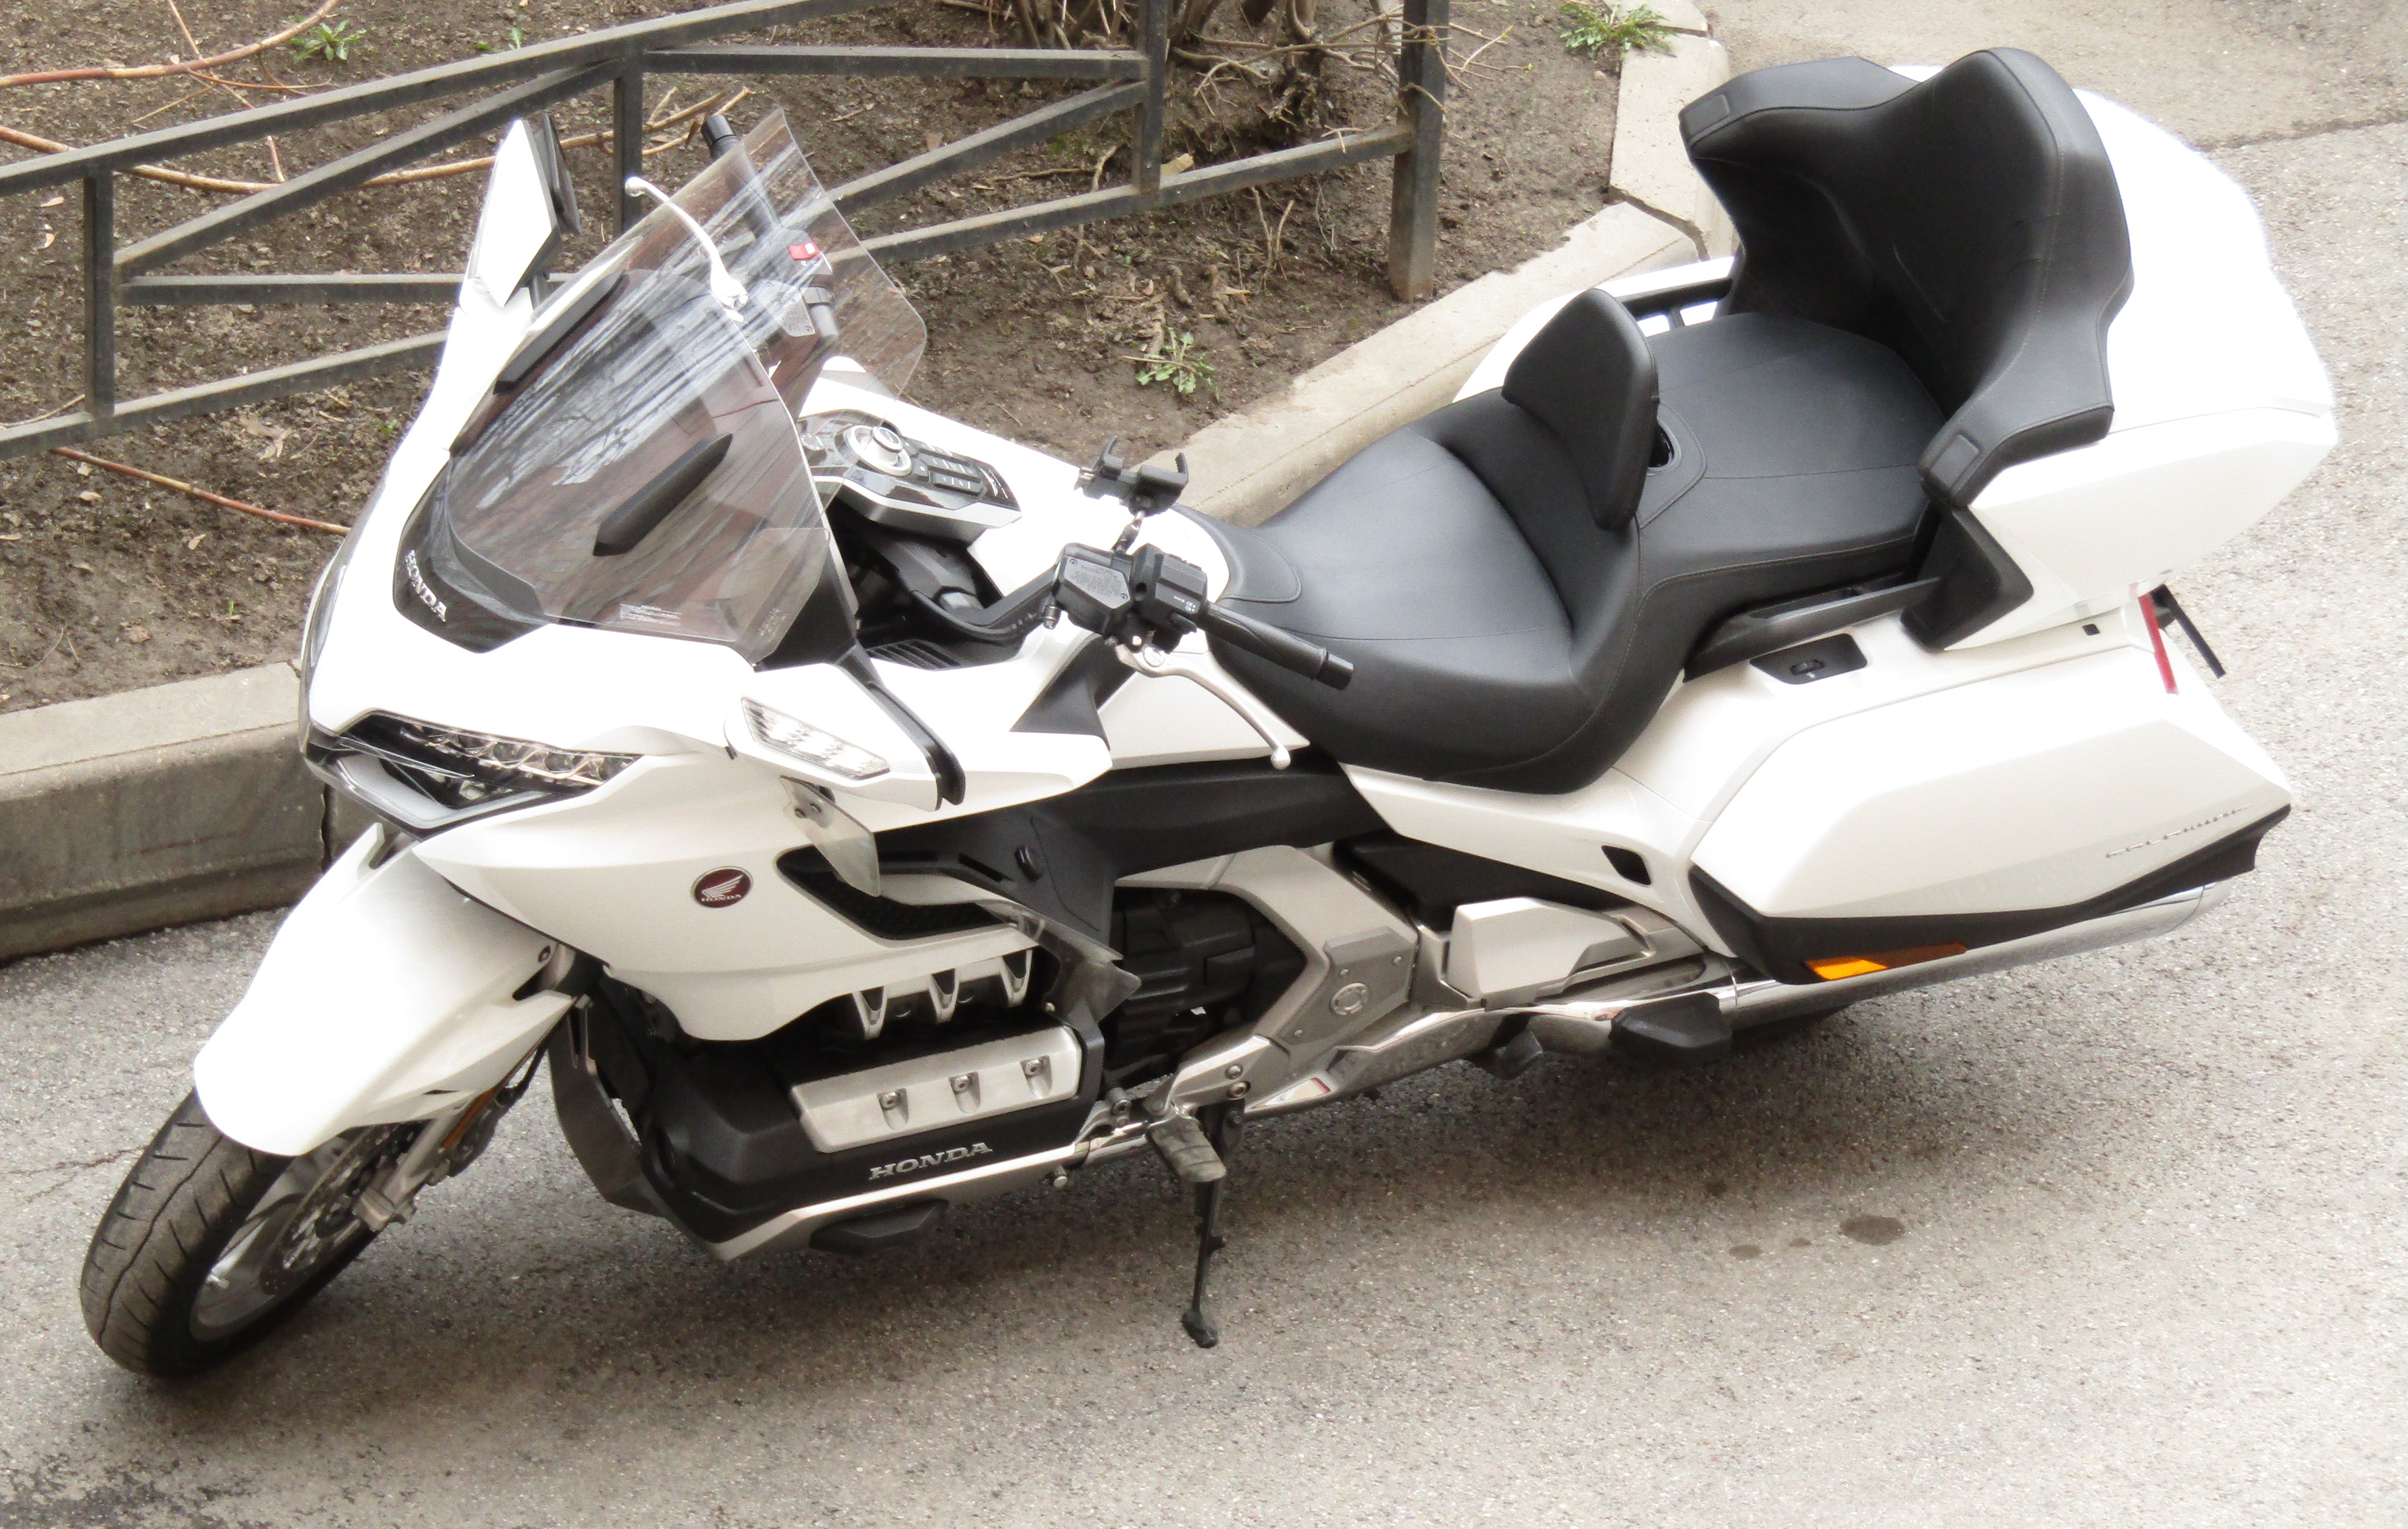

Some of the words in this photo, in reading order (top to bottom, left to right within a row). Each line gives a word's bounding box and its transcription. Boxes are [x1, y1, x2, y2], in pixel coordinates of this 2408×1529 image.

[406, 549, 447, 622] HONDA
[701, 894, 741, 902] HONDA
[869, 1142, 993, 1180] HONDA
